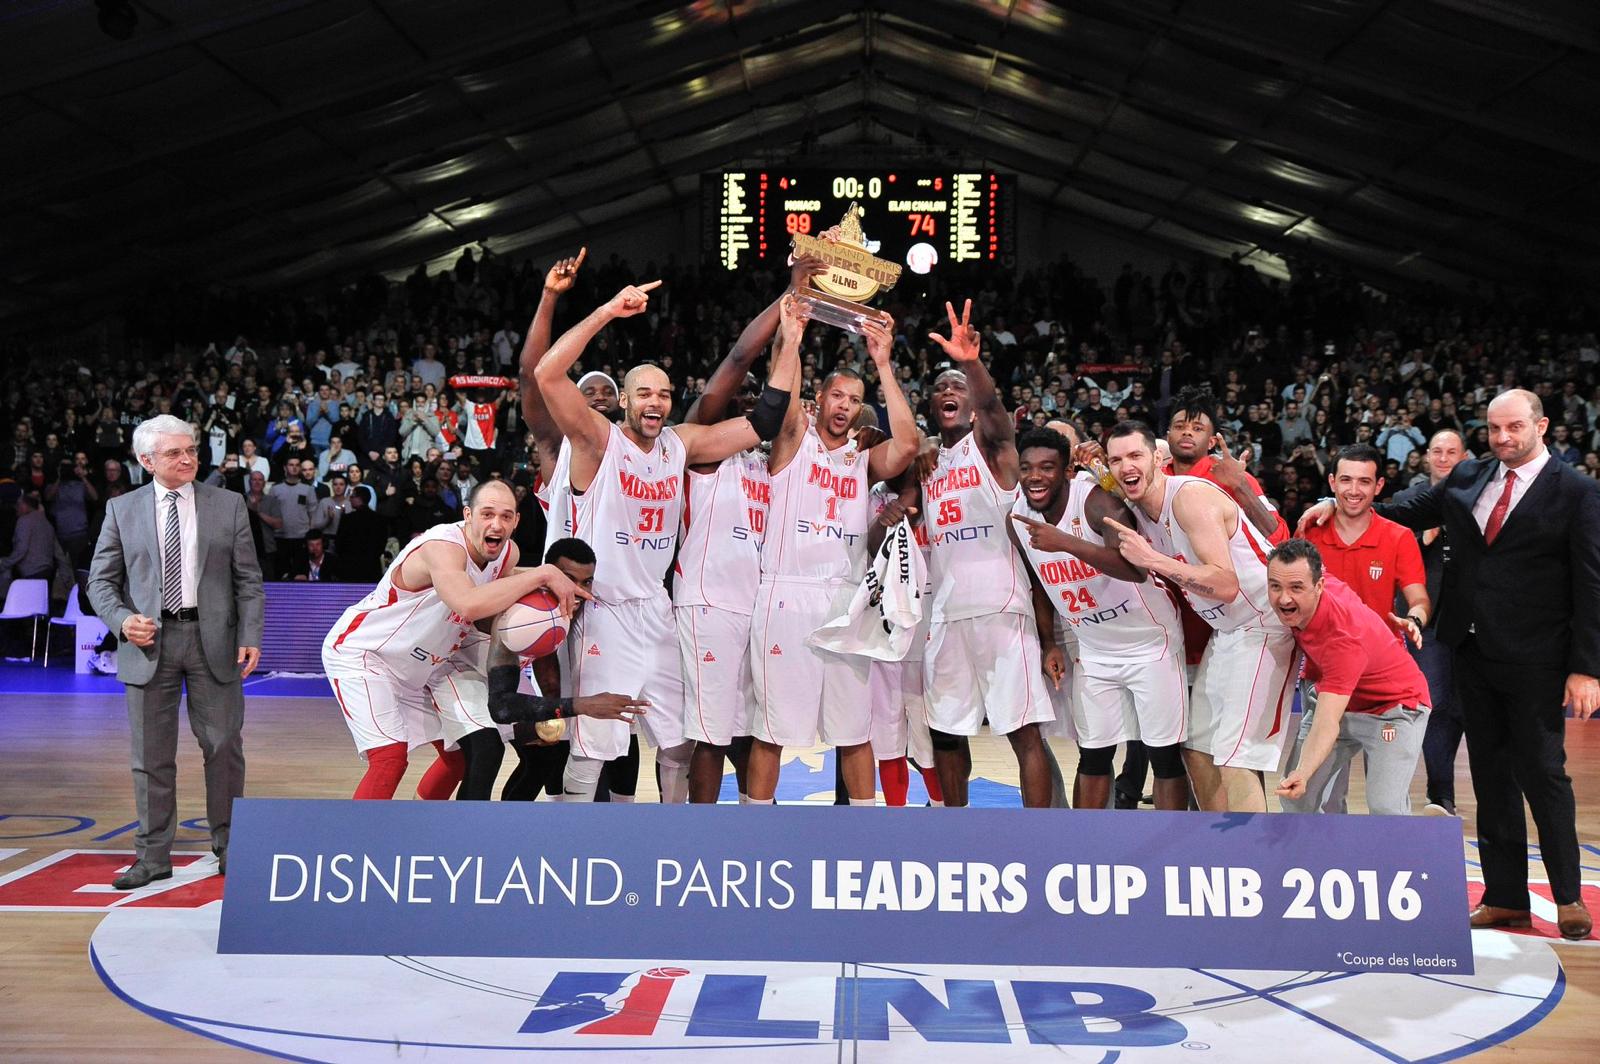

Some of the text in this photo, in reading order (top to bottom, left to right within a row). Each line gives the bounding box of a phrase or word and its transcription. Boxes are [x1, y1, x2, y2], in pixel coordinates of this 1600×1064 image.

[786, 213, 811, 234] 99
[908, 214, 935, 236] 74
[839, 275, 858, 290] LNB
[808, 463, 857, 499] MOACO
[927, 465, 982, 503] MOACO
[638, 507, 665, 532] 31
[936, 498, 962, 526] 35
[797, 520, 859, 546] SYNT
[1061, 586, 1098, 614] 24
[655, 858, 795, 910] PARIS
[811, 859, 1028, 914] LEADERS
[1044, 864, 1147, 916] CUP
[1164, 866, 1264, 918] LNB
[1388, 952, 1410, 966] des
[1413, 953, 1457, 968] leaders
